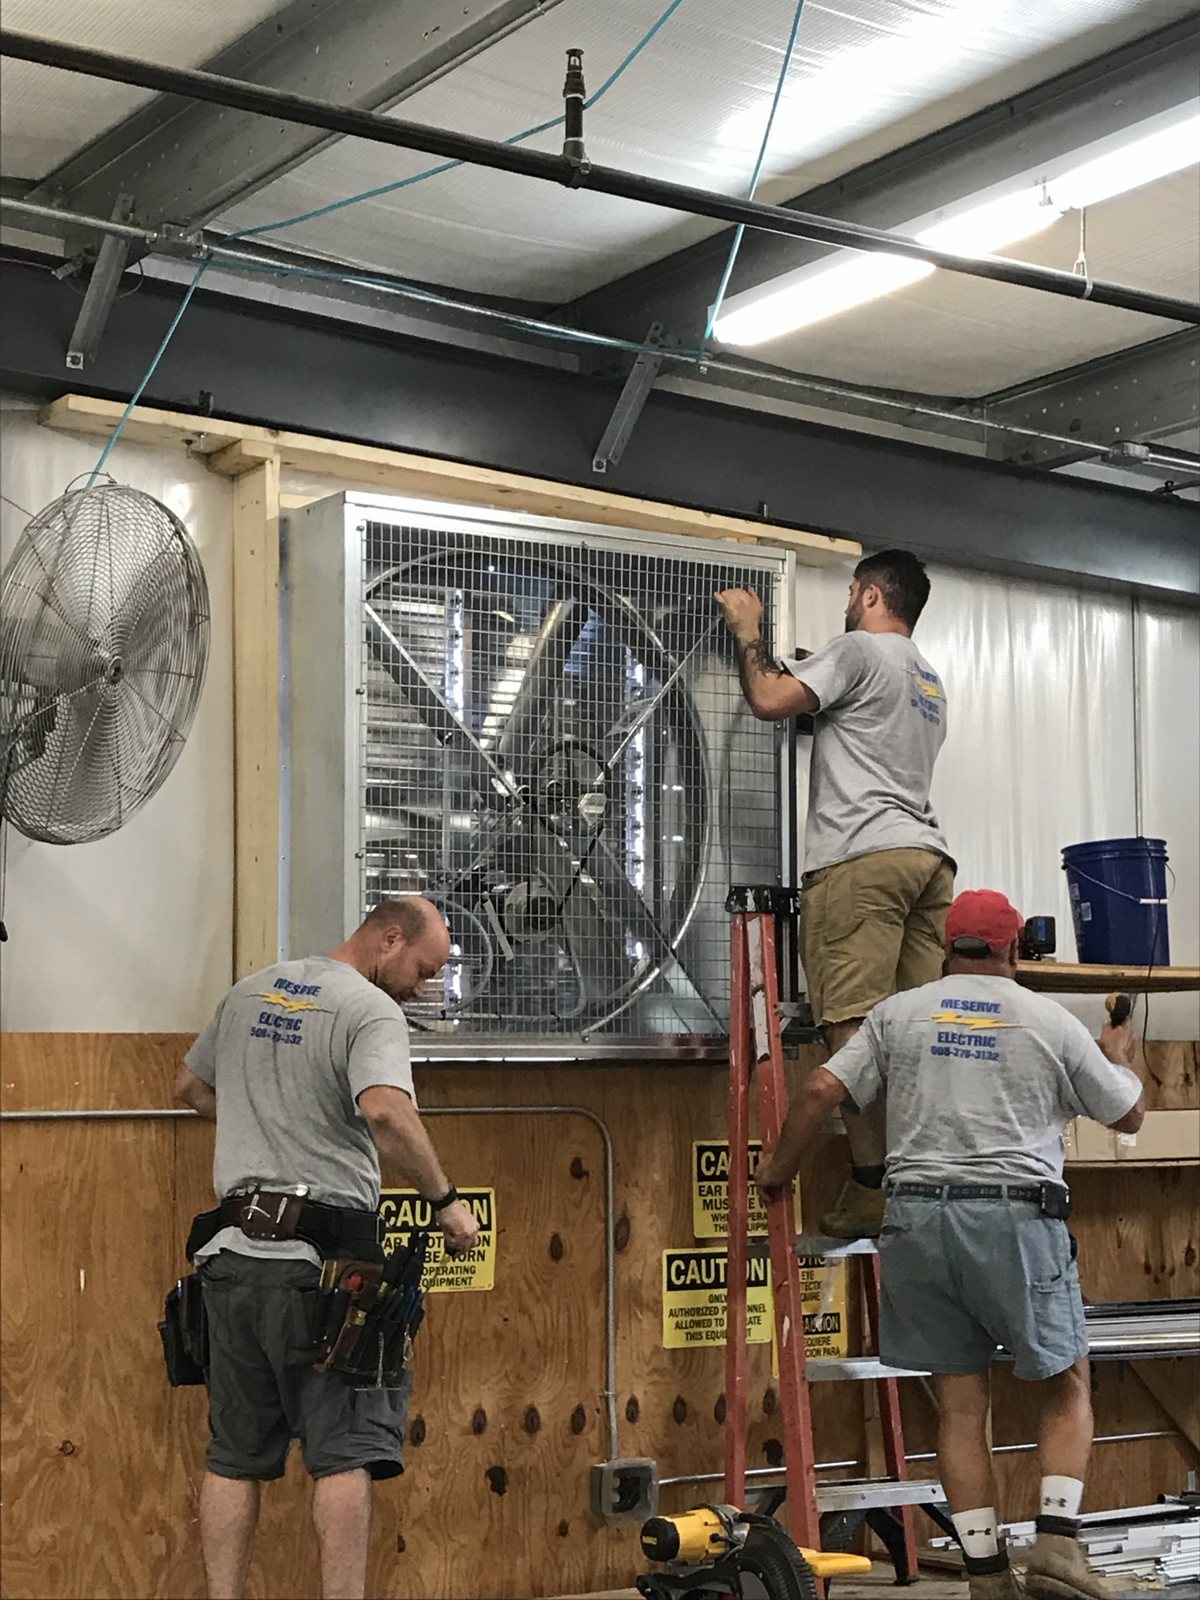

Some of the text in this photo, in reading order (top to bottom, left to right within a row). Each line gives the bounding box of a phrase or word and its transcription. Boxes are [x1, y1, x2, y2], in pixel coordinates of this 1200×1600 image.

[941, 999, 1001, 1014] MESERVE
[938, 1032, 996, 1048] ELECTRIC
[698, 1185, 722, 1196] EAR
[702, 1199, 728, 1210] MUS
[425, 1251, 441, 1263] BE
[423, 1265, 477, 1277] OPERATING
[671, 1258, 764, 1285] CAUTN
[422, 1276, 474, 1290] QUIPMENT
[668, 1306, 719, 1318] AUTHORIZED
[674, 1318, 725, 1330] ALLOWED TO
[685, 1331, 703, 1341] THIS
